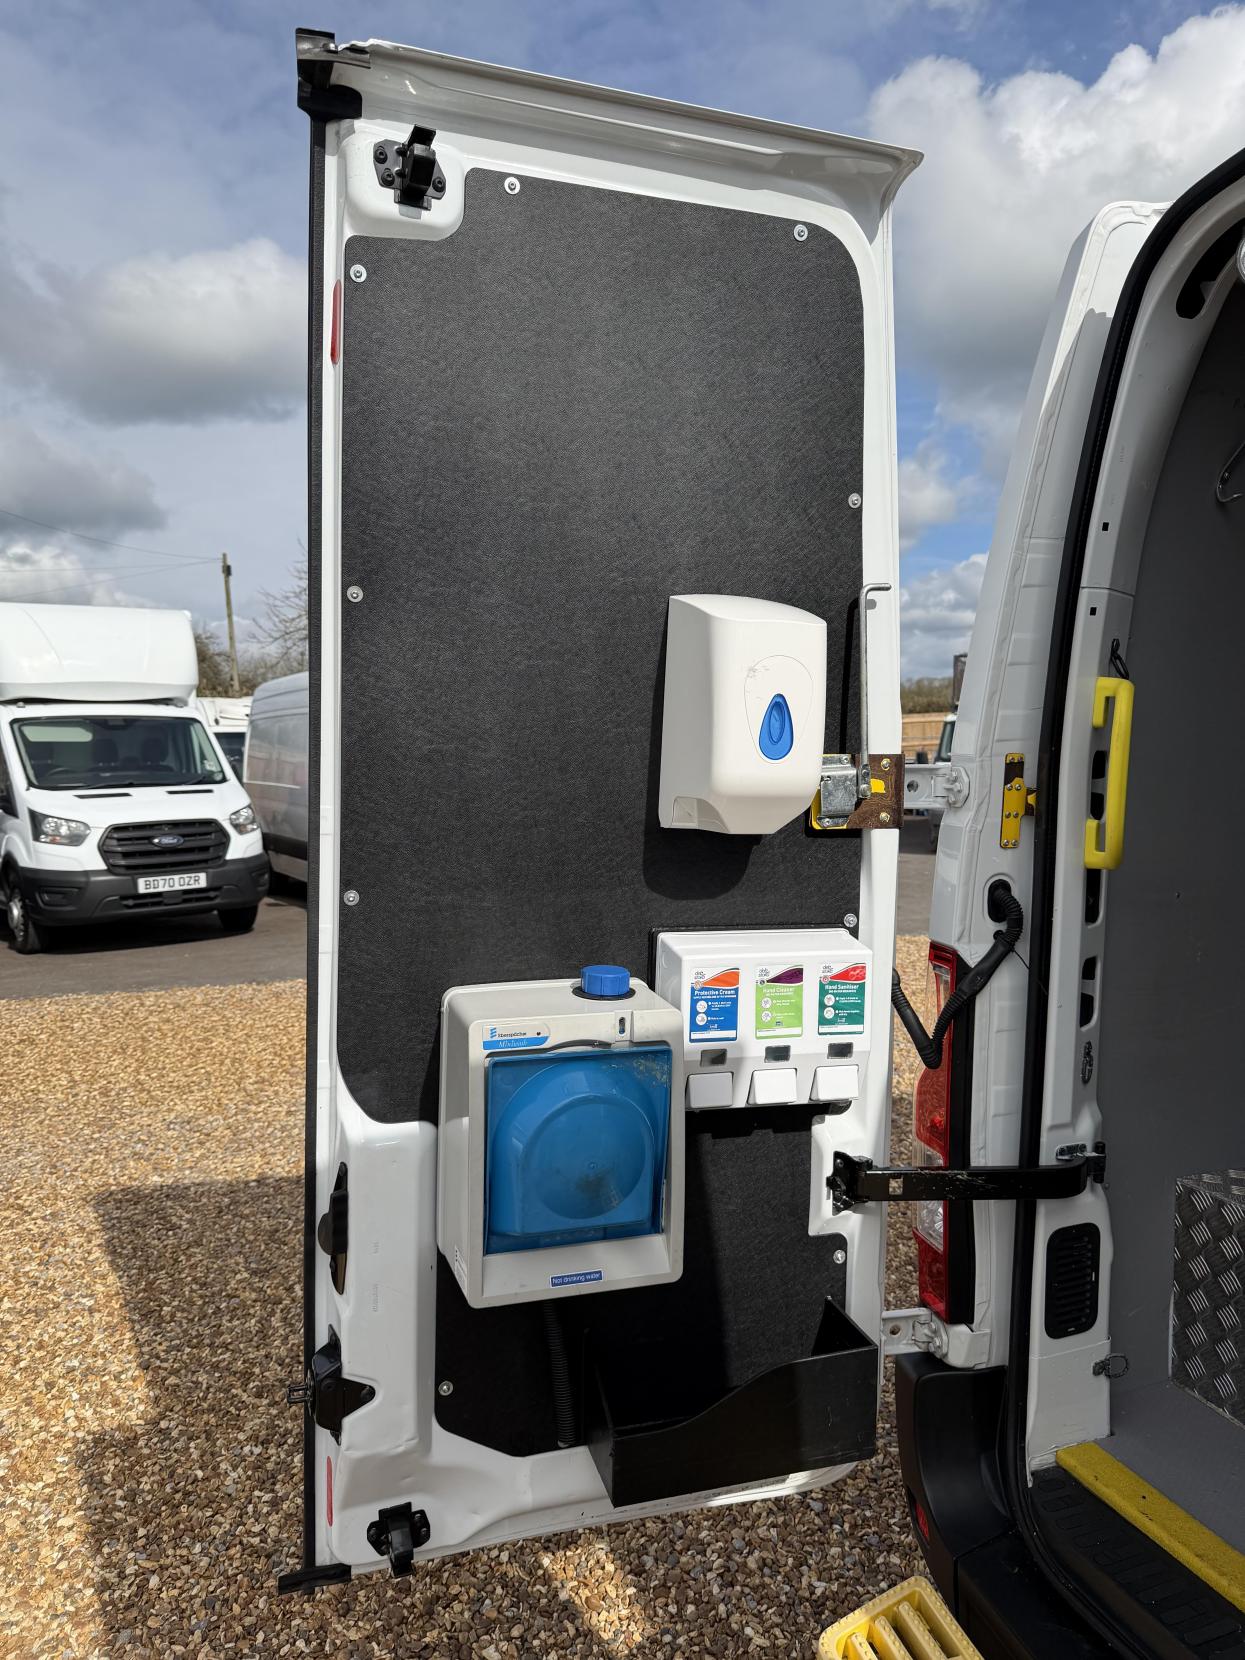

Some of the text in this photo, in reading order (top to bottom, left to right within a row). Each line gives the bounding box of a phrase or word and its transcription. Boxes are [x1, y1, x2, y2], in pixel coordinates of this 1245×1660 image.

[144, 875, 201, 890] BD70 OZR
[563, 1275, 585, 1283] drinking
